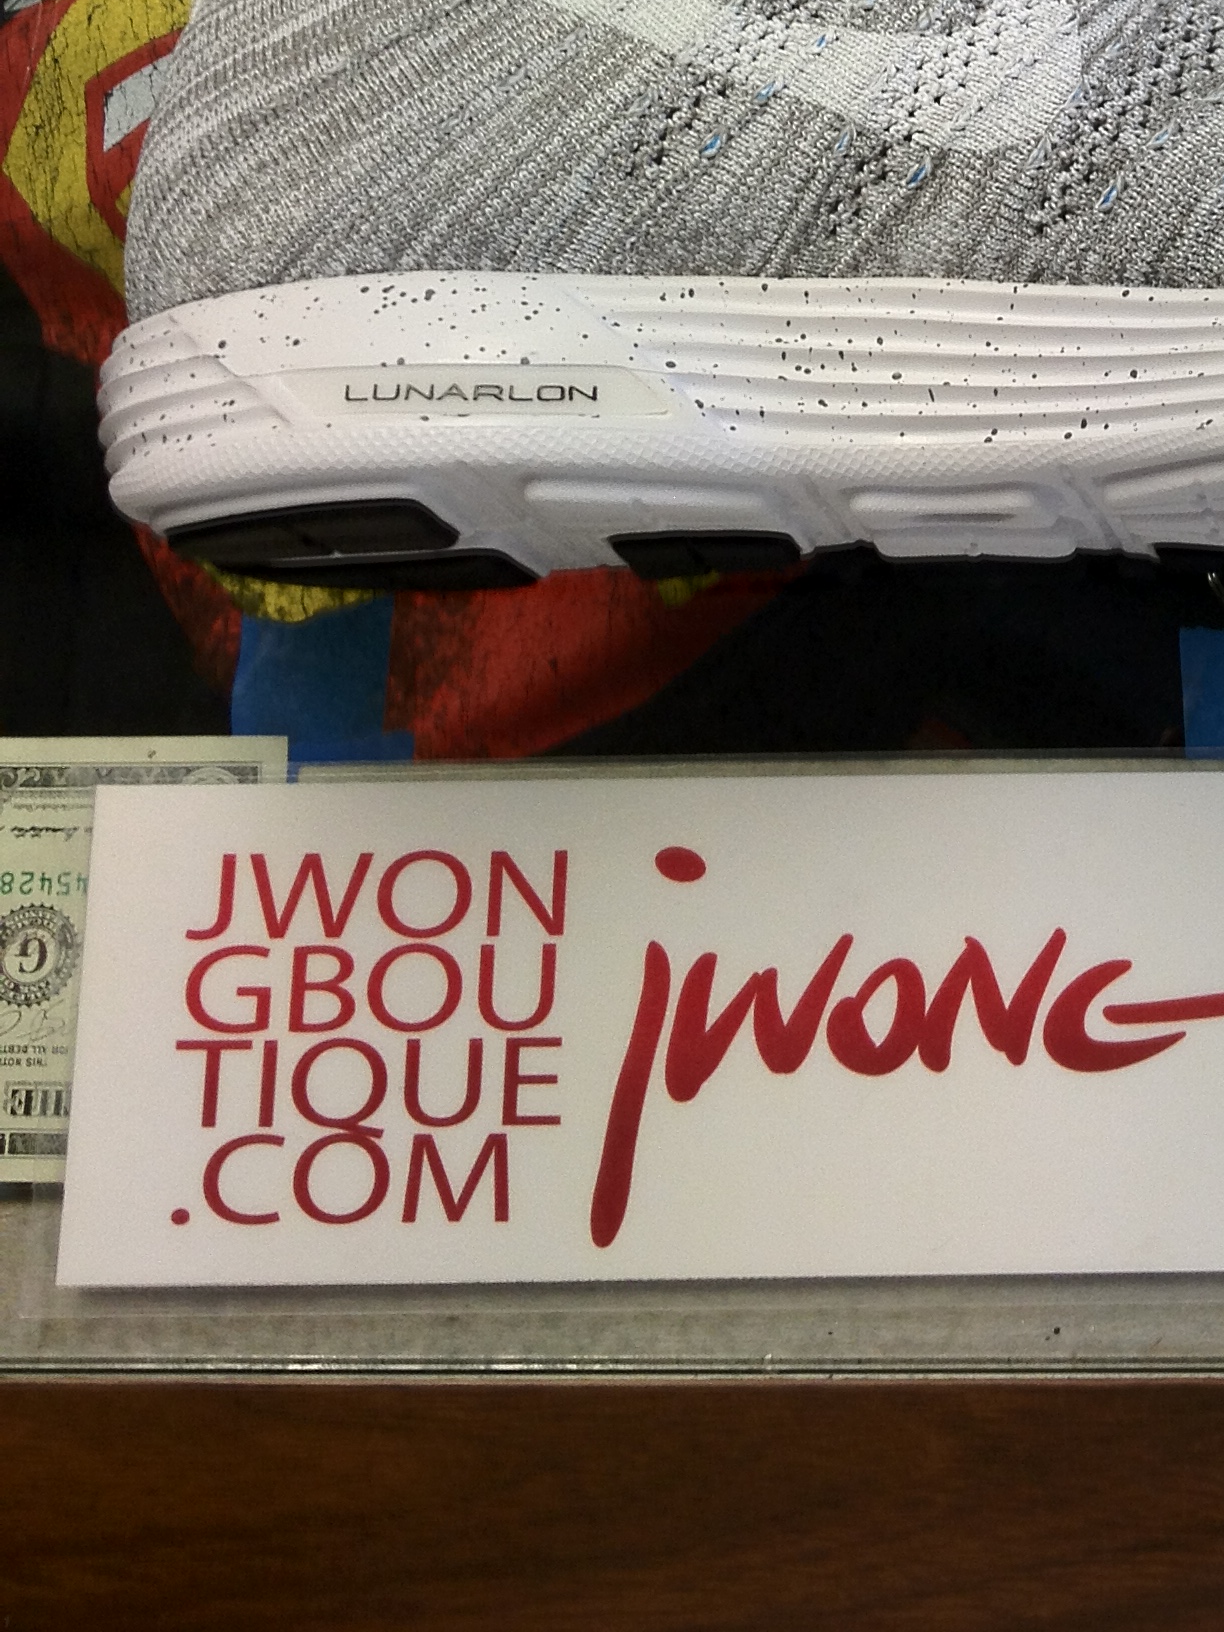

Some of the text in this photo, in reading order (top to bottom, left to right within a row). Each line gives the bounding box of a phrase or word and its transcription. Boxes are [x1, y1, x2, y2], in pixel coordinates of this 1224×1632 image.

[344, 383, 598, 402] LUNARLON
[185, 848, 568, 941] JWON
[184, 942, 557, 1034] GBOU
[175, 1036, 563, 1139] TIQUE
[170, 1132, 510, 1226] .COM
